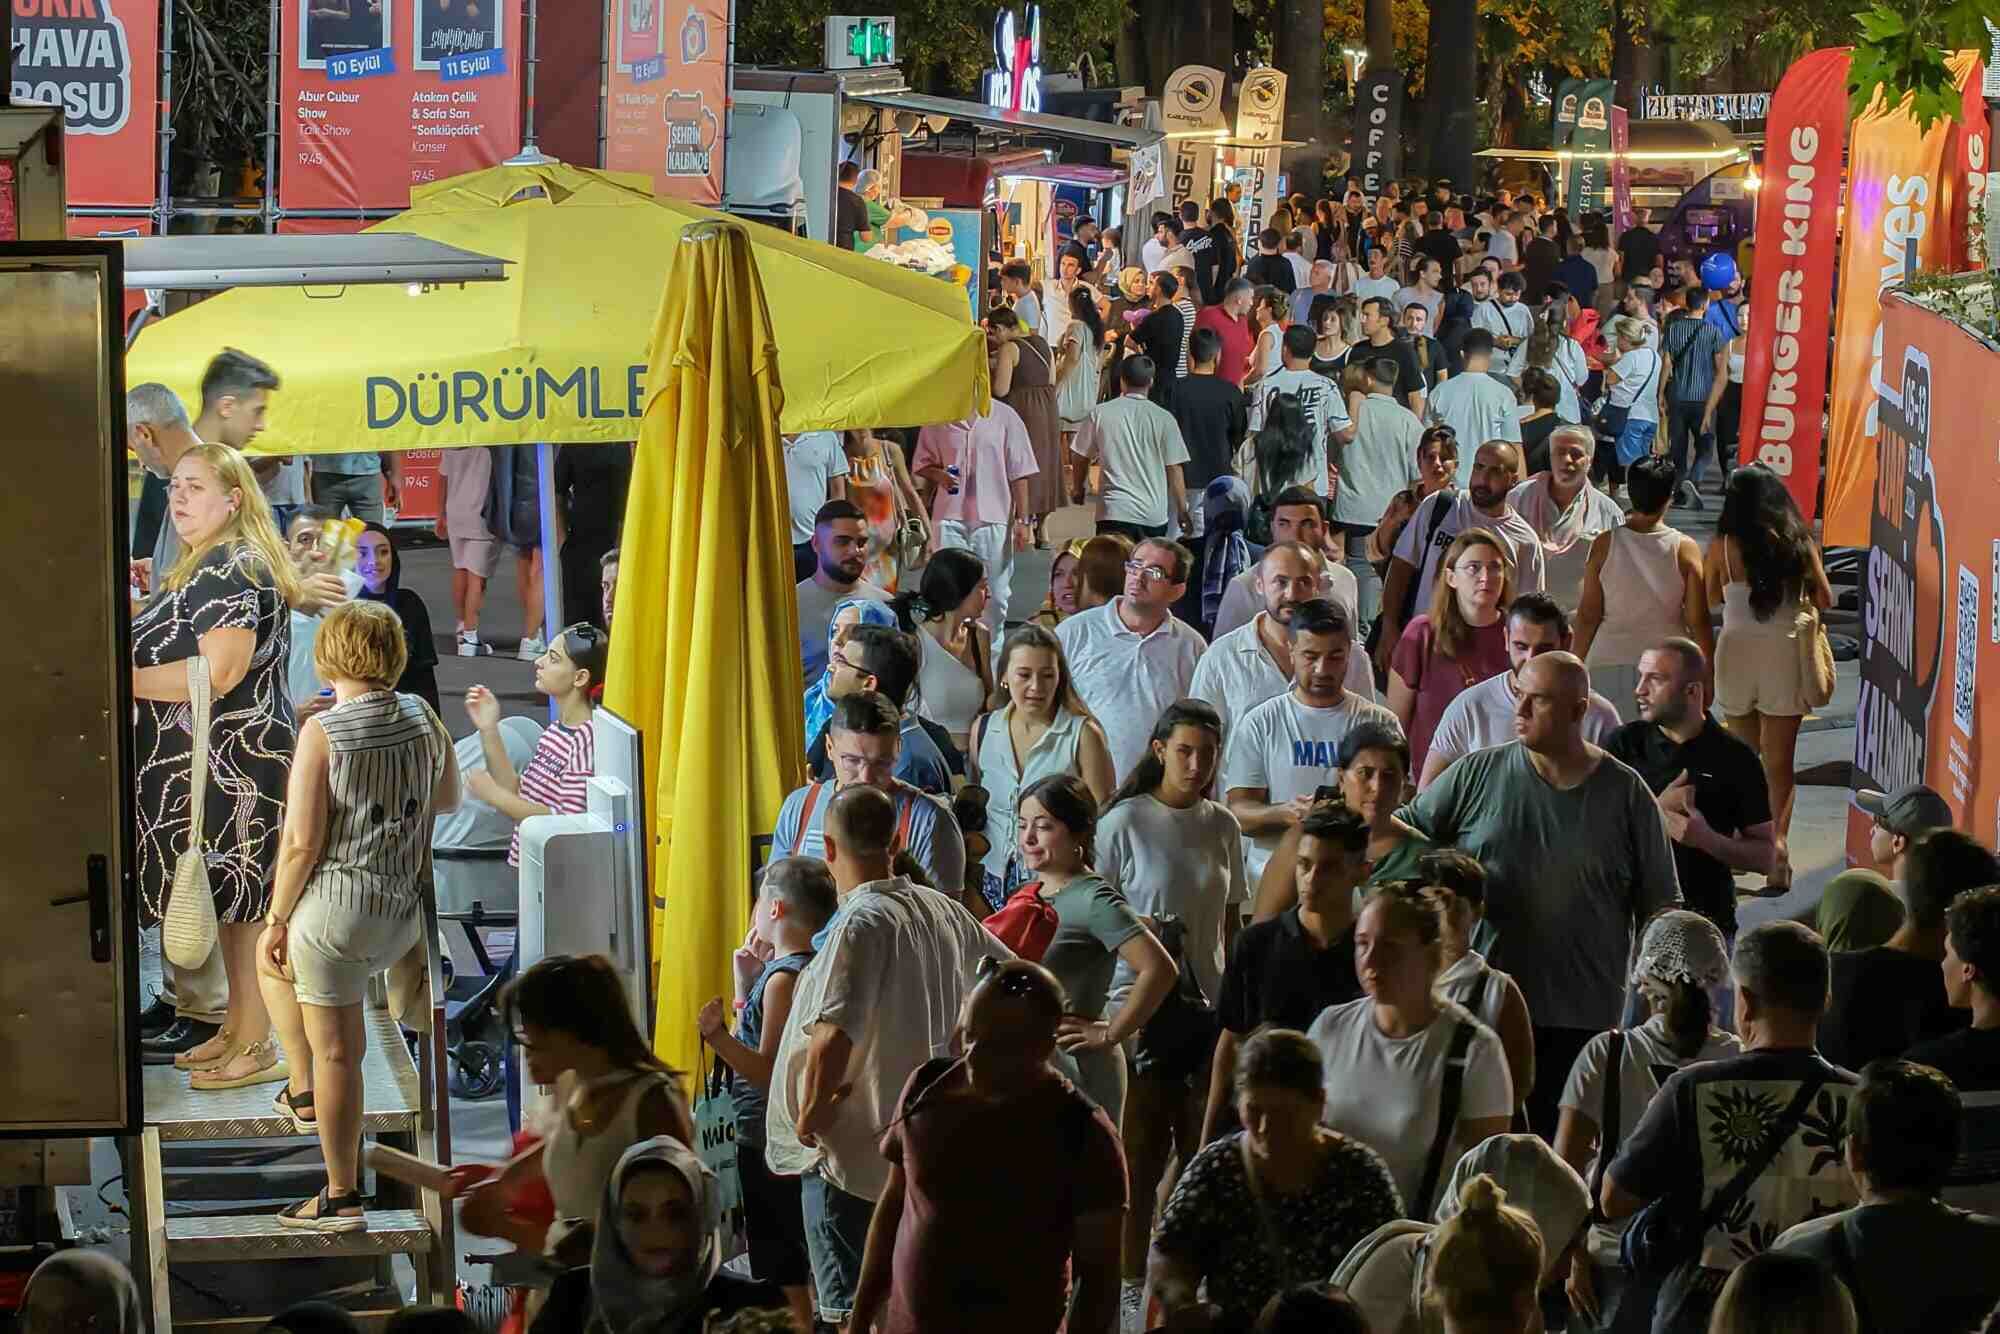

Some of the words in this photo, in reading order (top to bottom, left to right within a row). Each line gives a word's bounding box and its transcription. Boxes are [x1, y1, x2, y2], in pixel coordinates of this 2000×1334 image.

[332, 61, 346, 75] 10
[350, 56, 381, 75] Eylül
[447, 62, 458, 76] 11
[461, 56, 491, 75] Eylül
[298, 91, 325, 102] Abur
[327, 91, 360, 103] Cubur
[412, 91, 449, 103] Atakan
[452, 91, 478, 105] Çelik
[298, 107, 326, 119] Show
[412, 108, 420, 119] &
[422, 108, 447, 119] Safa
[322, 124, 352, 136] Show
[412, 141, 447, 153] Konser
[1760, 270, 1803, 477] BURGER
[1783, 126, 1819, 256] KING
[1905, 375, 1927, 434] 05-13
